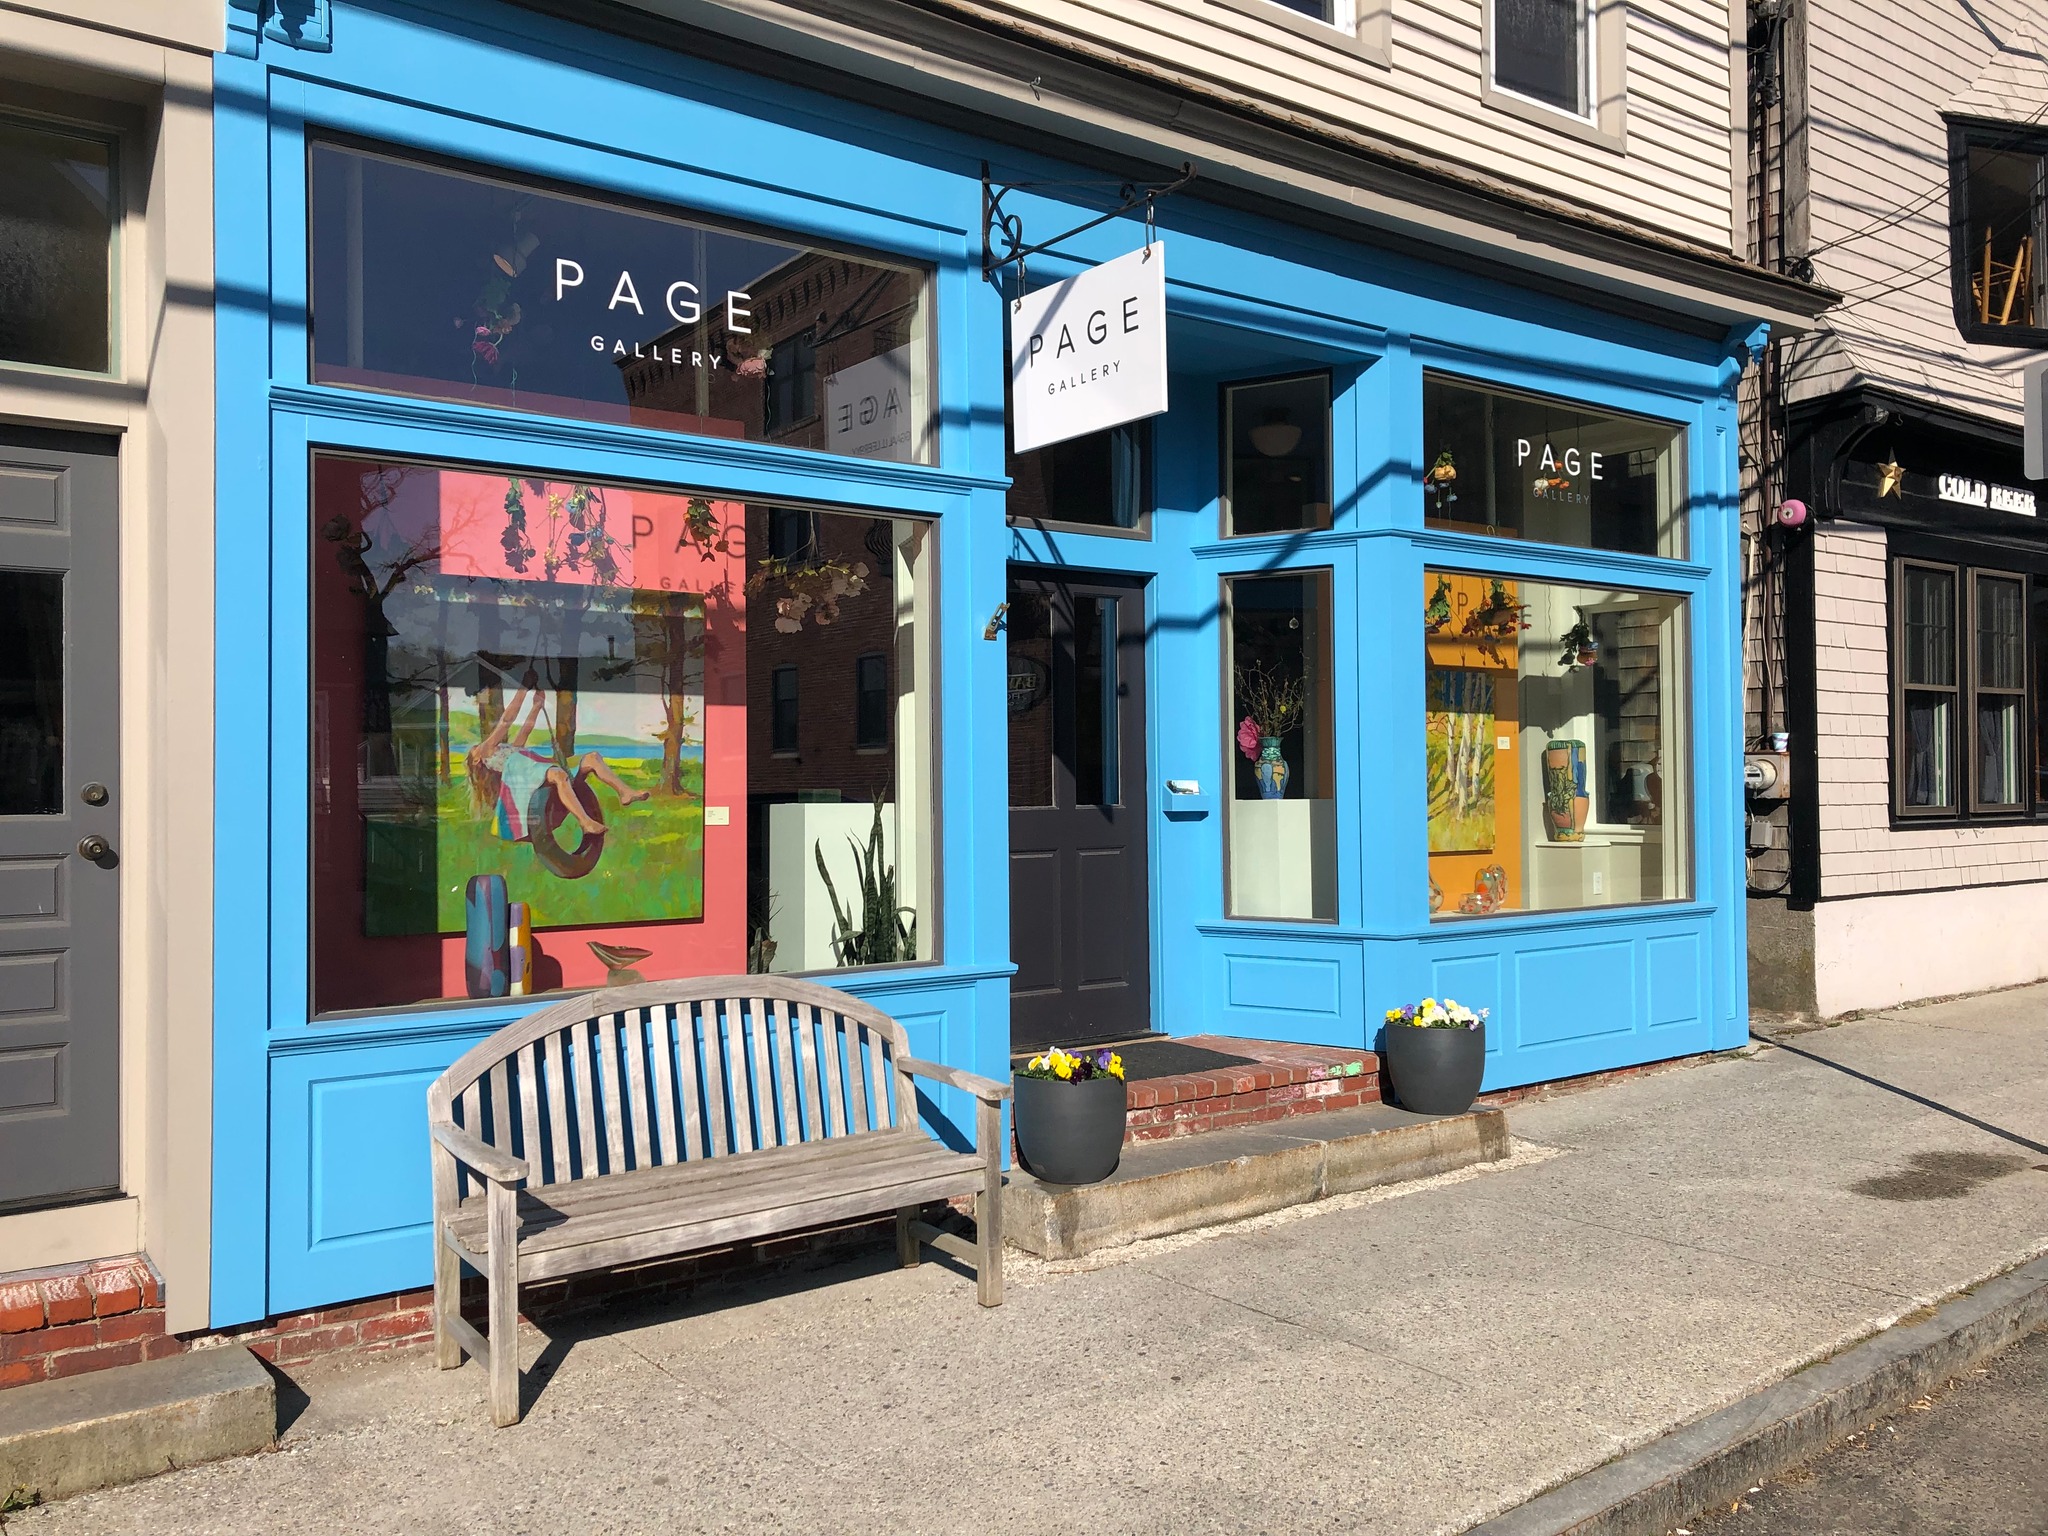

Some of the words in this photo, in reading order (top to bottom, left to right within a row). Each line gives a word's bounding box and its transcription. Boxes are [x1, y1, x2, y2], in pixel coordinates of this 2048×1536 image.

[556, 258, 752, 334] PAGE
[590, 335, 721, 370] GALLERY
[1029, 296, 1139, 368] PAGE
[1047, 359, 1121, 395] GALLERY
[1517, 438, 1604, 480] PAGE
[1533, 487, 1590, 505] GALLERY
[1938, 473, 1988, 509] COLD
[1989, 482, 2037, 517] BEER
